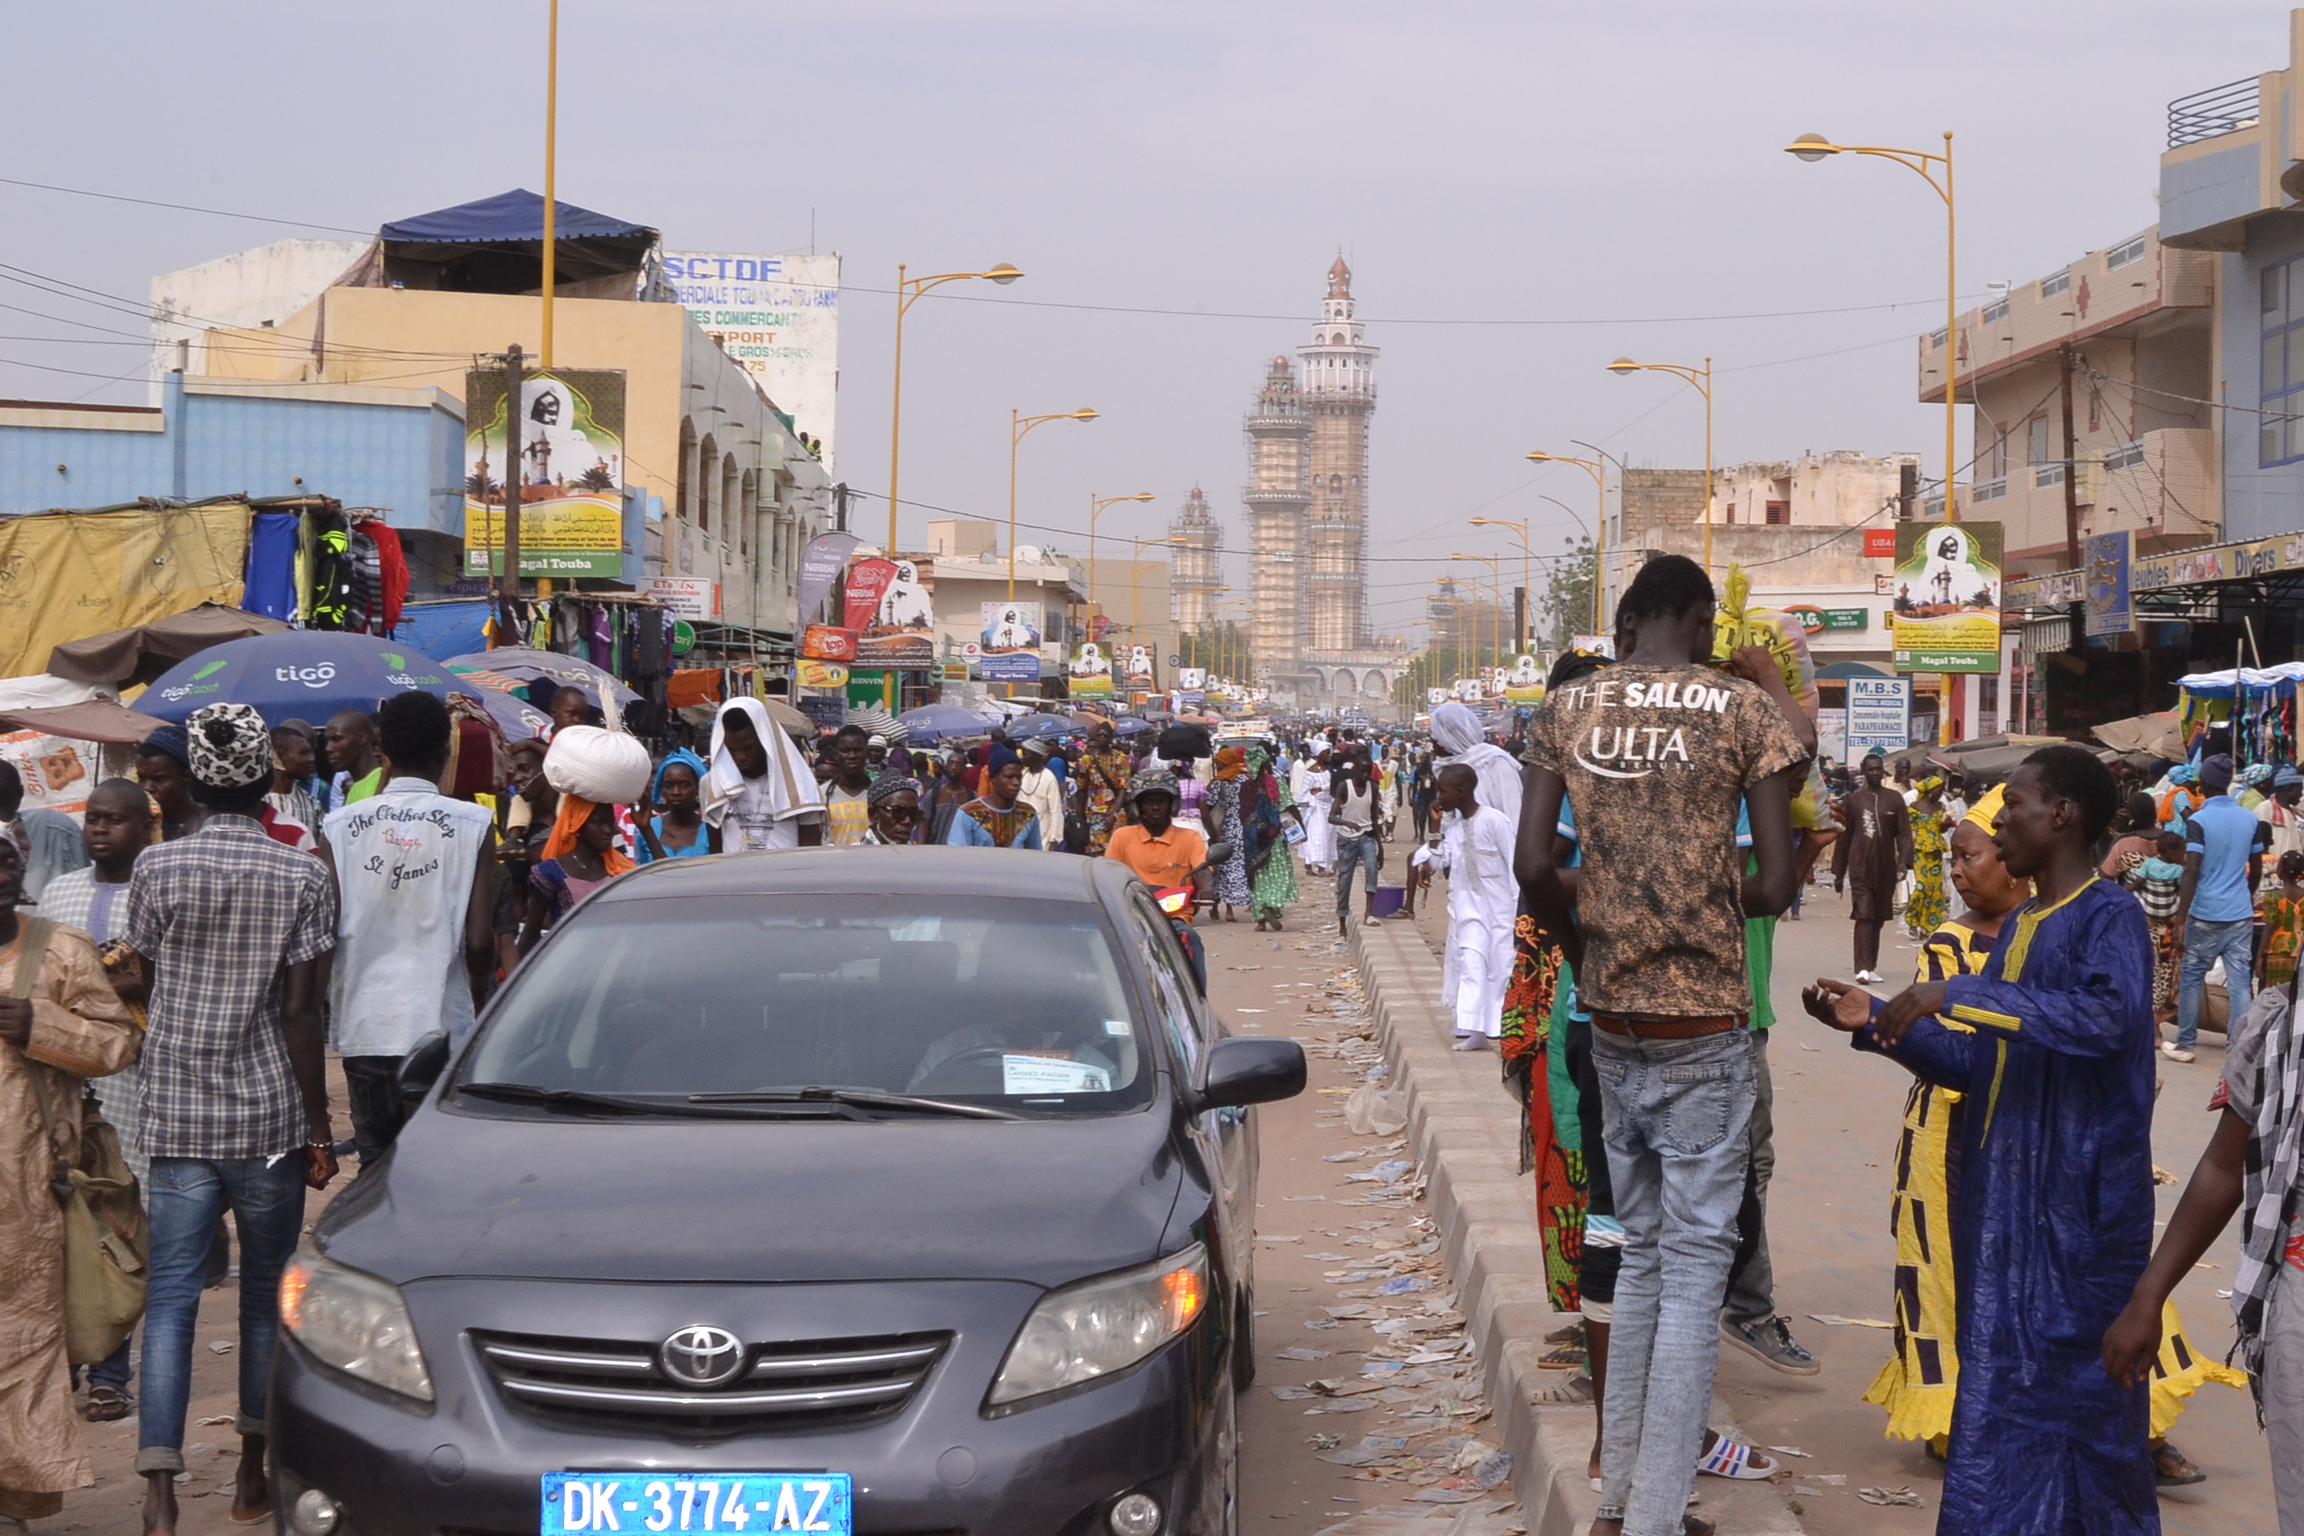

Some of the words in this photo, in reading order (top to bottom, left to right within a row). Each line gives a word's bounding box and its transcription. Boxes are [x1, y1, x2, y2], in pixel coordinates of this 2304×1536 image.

[519, 559, 548, 570] agal
[550, 558, 592, 569] Touba
[1921, 656, 1948, 666] Magal
[1950, 656, 1978, 665] Touba
[1566, 680, 1620, 709] THE
[1624, 682, 1731, 713] SALON
[1855, 682, 1902, 694] M.B.S
[1591, 726, 1690, 762] ULTA
[347, 812, 375, 838] The
[375, 804, 427, 822] Clothes
[425, 809, 456, 839] Shop
[390, 858, 439, 890] James
[563, 1481, 832, 1532] DK-3774-AZ
